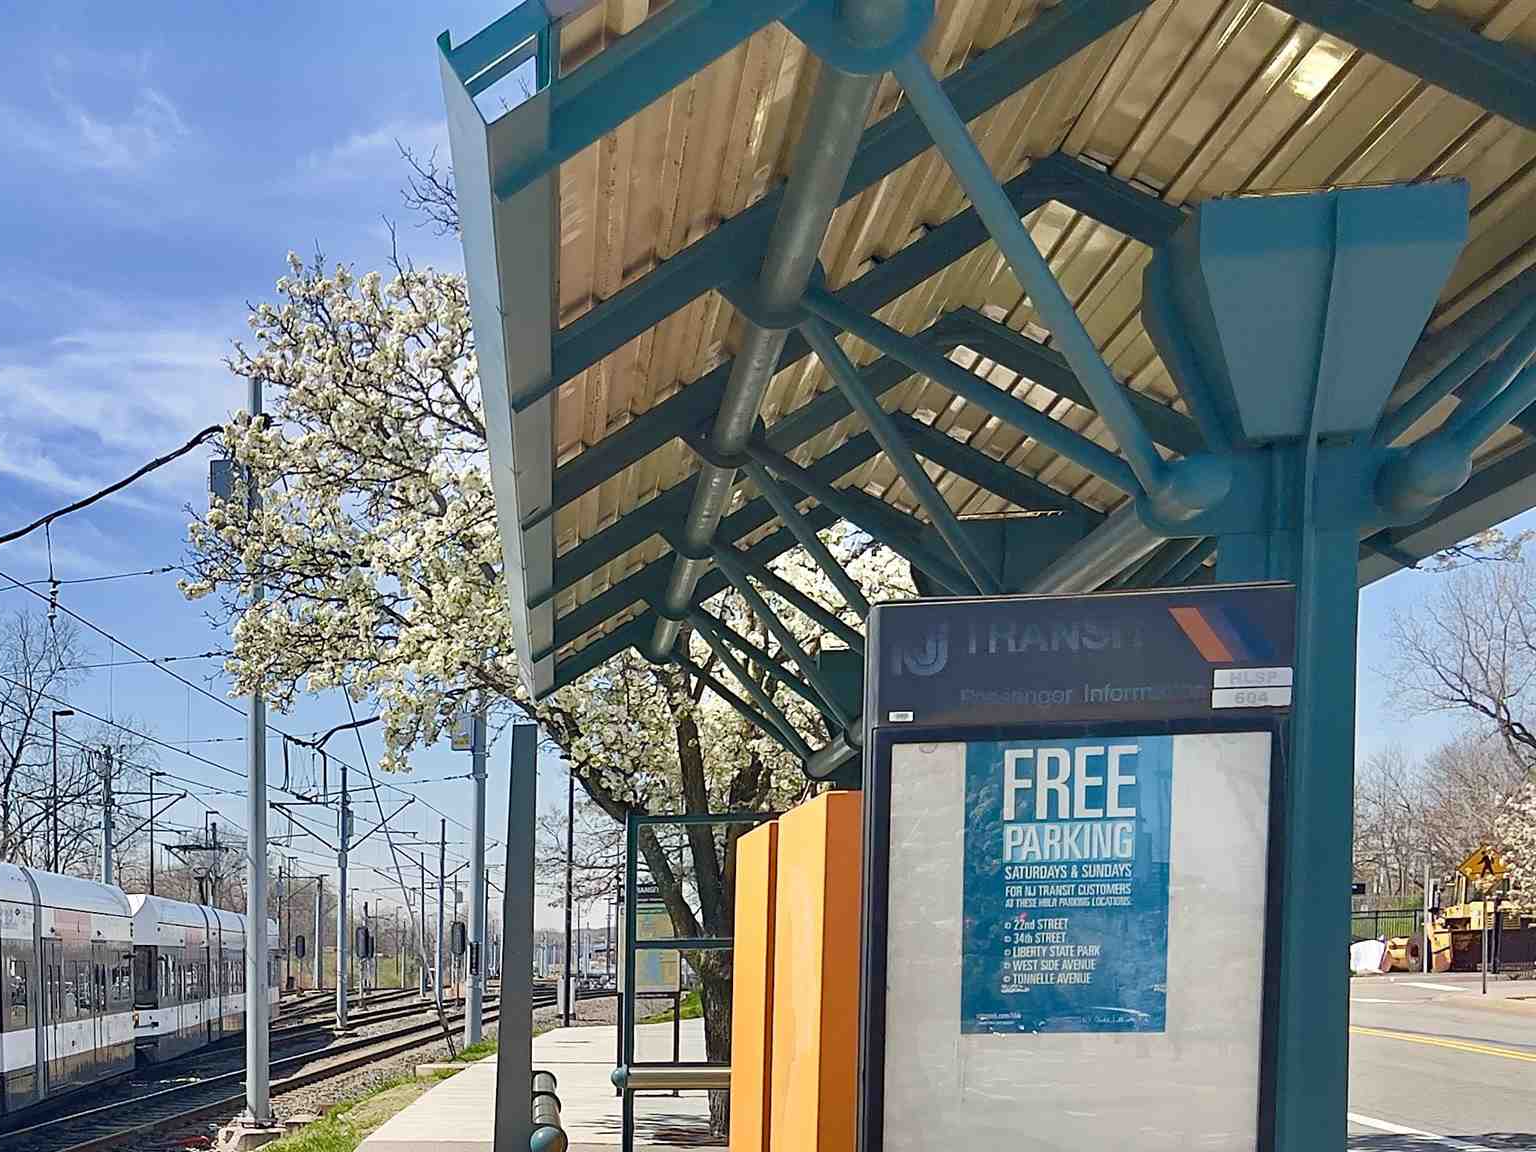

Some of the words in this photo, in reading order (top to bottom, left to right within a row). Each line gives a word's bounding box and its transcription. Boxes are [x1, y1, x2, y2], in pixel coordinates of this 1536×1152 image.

[892, 624, 950, 676] NJ
[967, 620, 1143, 656] TRANSIT
[1003, 744, 1138, 821] FREE
[1003, 822, 1134, 862] PARKING
[1004, 864, 1067, 881] SATURDAYS
[1070, 866, 1078, 879] &
[1081, 863, 1133, 878] SUNDAYS
[1005, 885, 1023, 897] FOR
[1024, 885, 1037, 896] NJ
[1038, 884, 1075, 896] TRANSIT
[1077, 882, 1132, 896] CUSTOMERS
[1013, 919, 1035, 931] 22nd
[1037, 917, 1069, 930] STREET
[1013, 933, 1033, 944] 34th
[1034, 932, 1066, 943] STREET
[1012, 946, 1047, 958] LIBERTY
[1049, 945, 1076, 957] STATE
[1076, 945, 1101, 956] PARK
[1012, 960, 1038, 971] WEST
[1040, 959, 1060, 971] SIDE
[1062, 959, 1096, 970] AVENUE
[1012, 973, 1056, 985] TONNELLE
[1057, 972, 1091, 984] AVENUE
